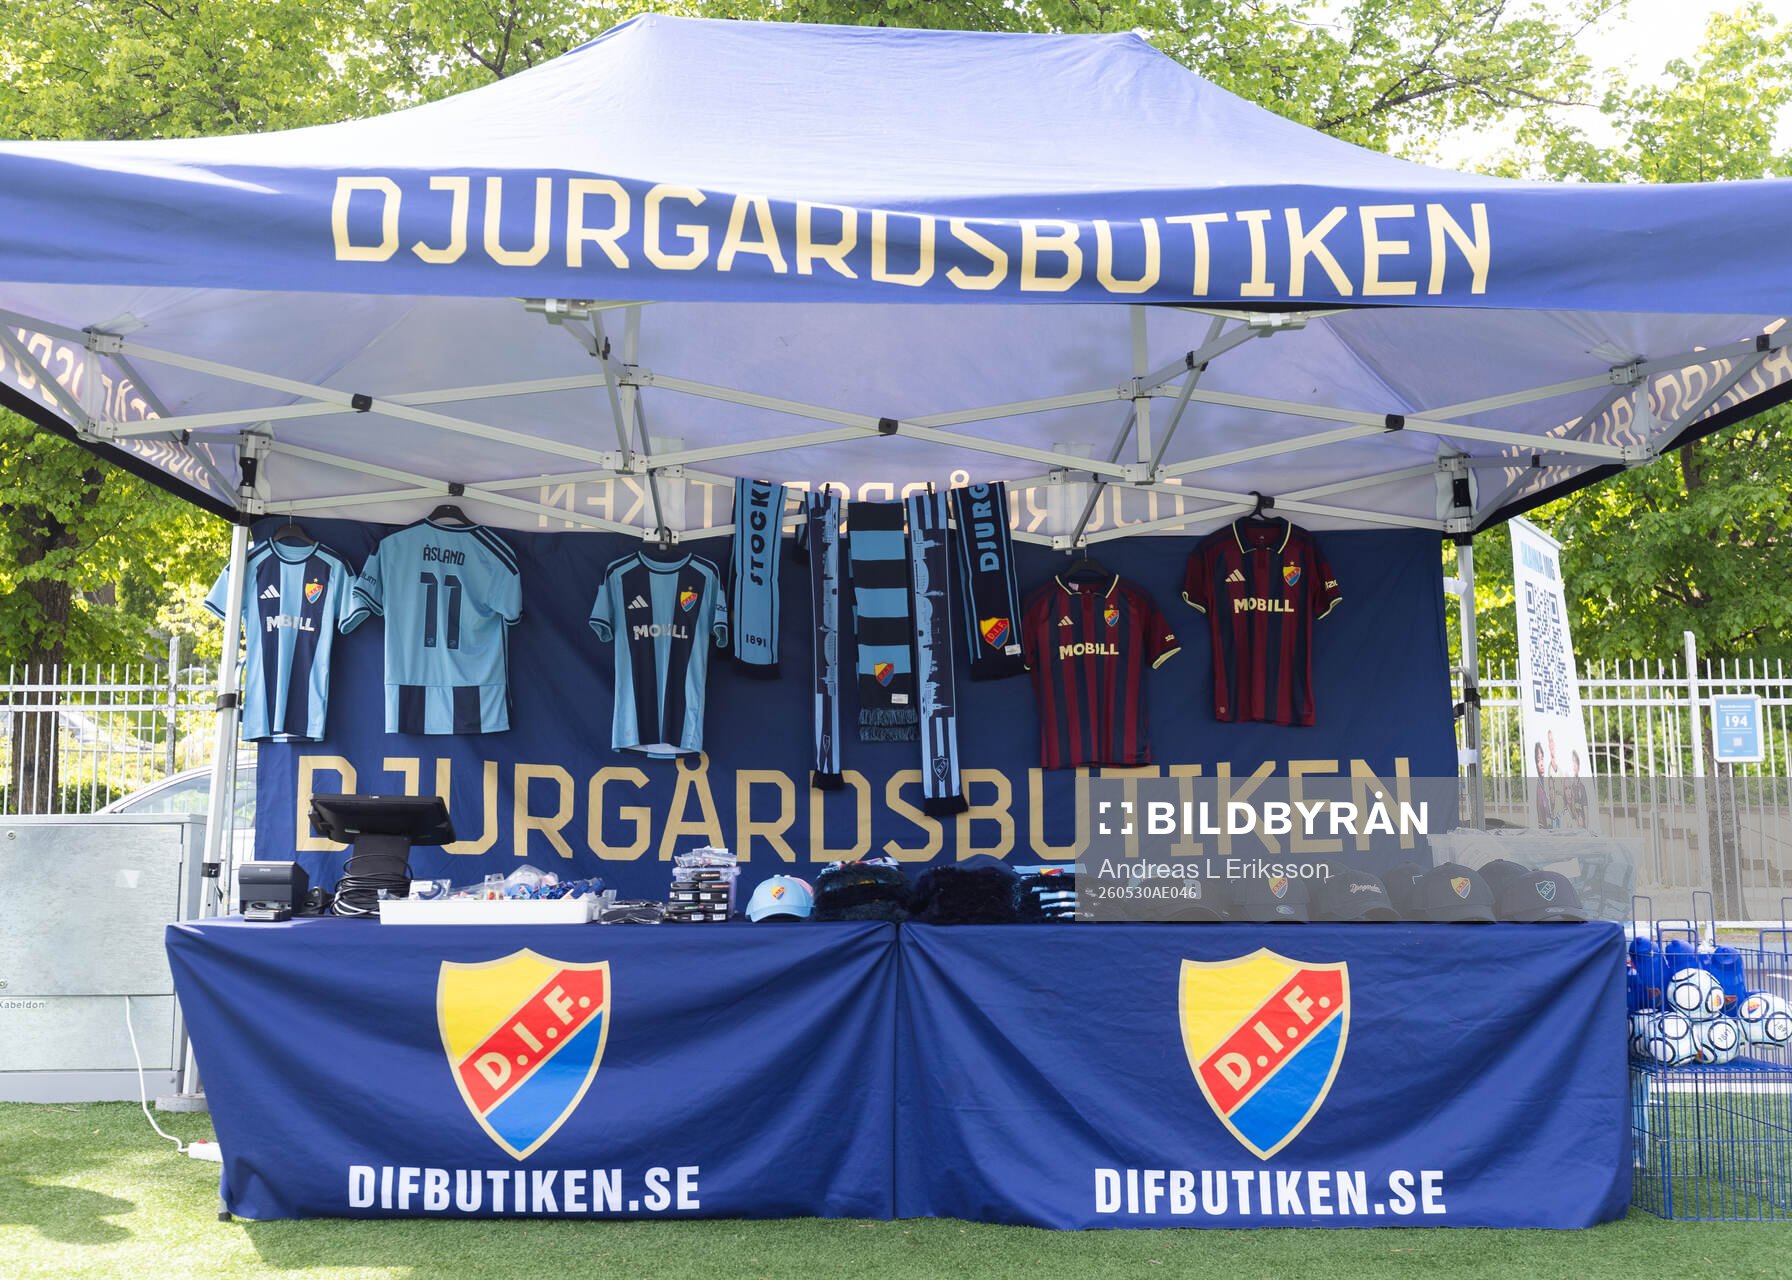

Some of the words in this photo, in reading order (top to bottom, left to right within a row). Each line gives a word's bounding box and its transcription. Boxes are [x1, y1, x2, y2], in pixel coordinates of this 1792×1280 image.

[423, 544, 466, 566] ÅSLAND
[420, 571, 463, 650] 11
[1233, 597, 1295, 614] MOBILL
[745, 633, 767, 648] 1891
[1058, 642, 1120, 661] MOBILL
[1725, 715, 1748, 728] 194
[473, 984, 591, 1091] D.I.F.
[1213, 984, 1331, 1092] D.I.F.
[348, 1165, 702, 1213] DIFBUTIKEN.SE
[1093, 1168, 1448, 1216] DIFBUTIKEN.SE
